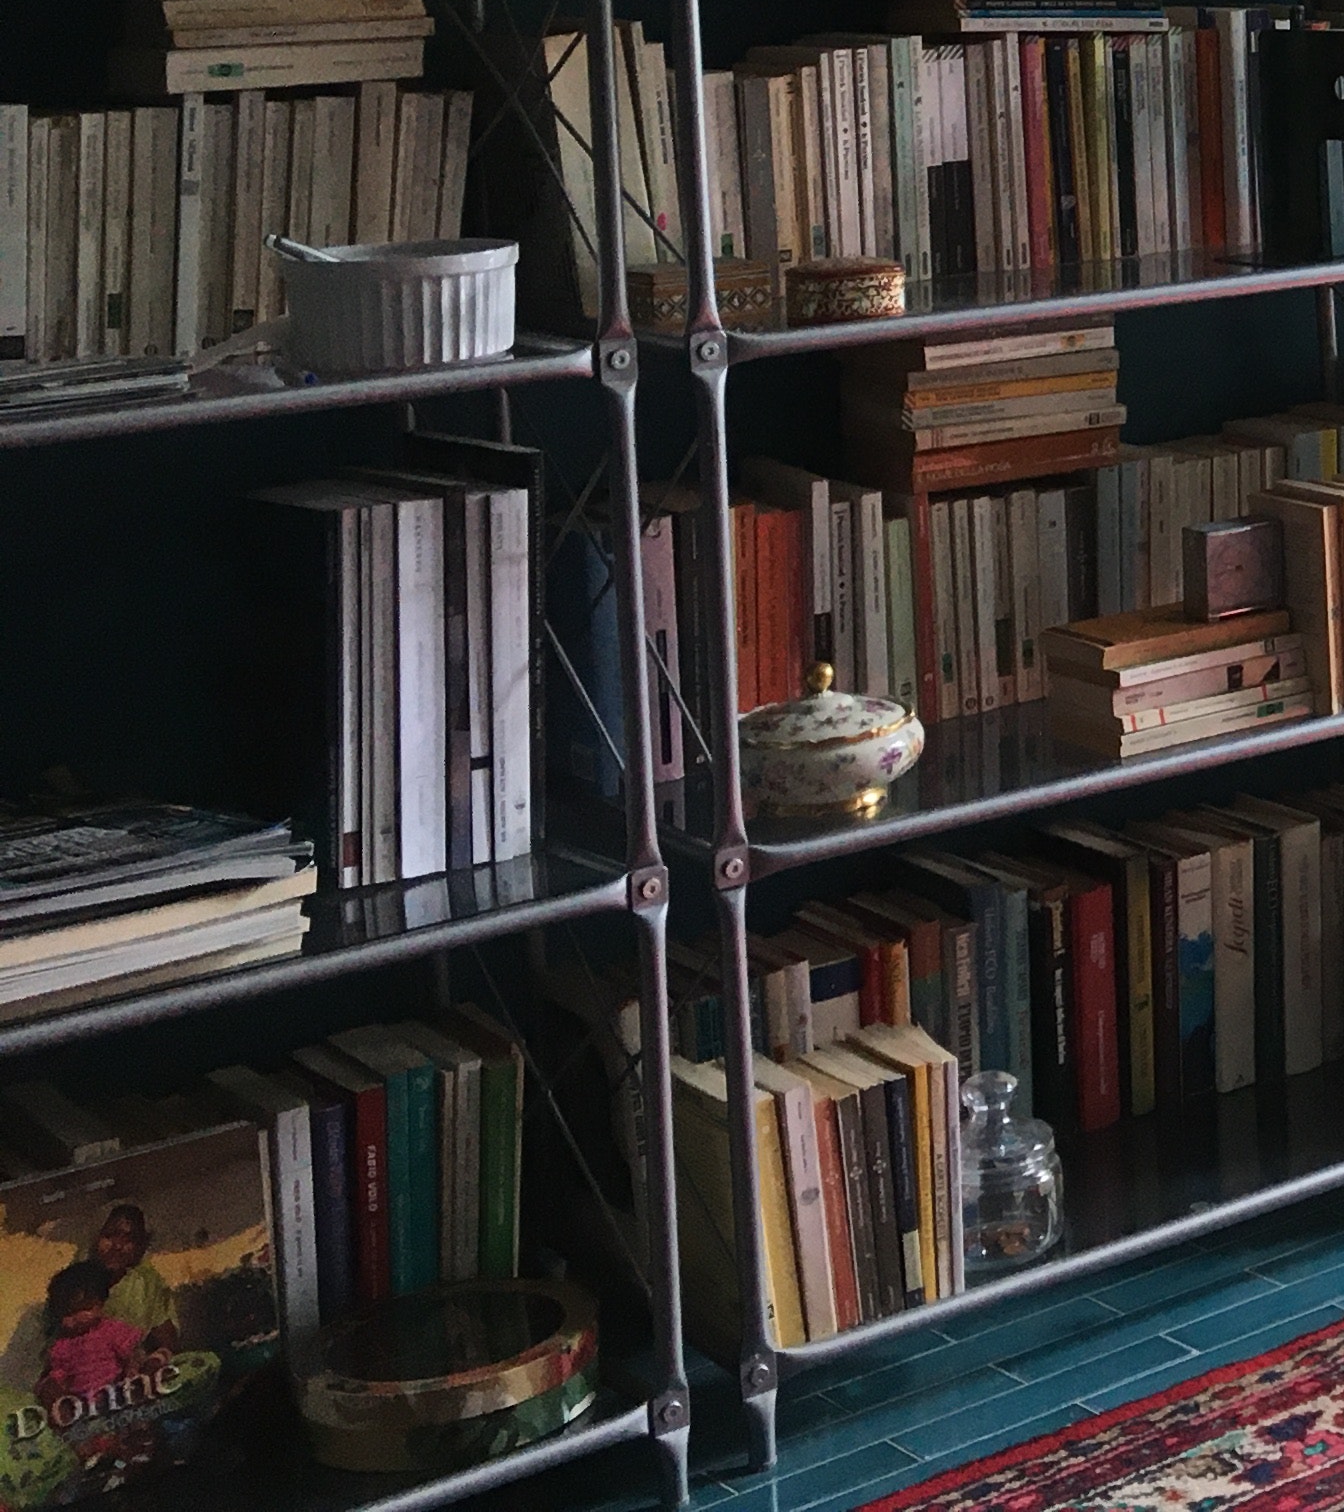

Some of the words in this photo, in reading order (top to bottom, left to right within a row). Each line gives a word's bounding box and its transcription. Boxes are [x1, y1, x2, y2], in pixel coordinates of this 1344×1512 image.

[983, 949, 997, 980] ECO
[366, 1144, 378, 1178] FABIO
[367, 1181, 379, 1213] VOLO
[12, 1363, 183, 1440] Donne
